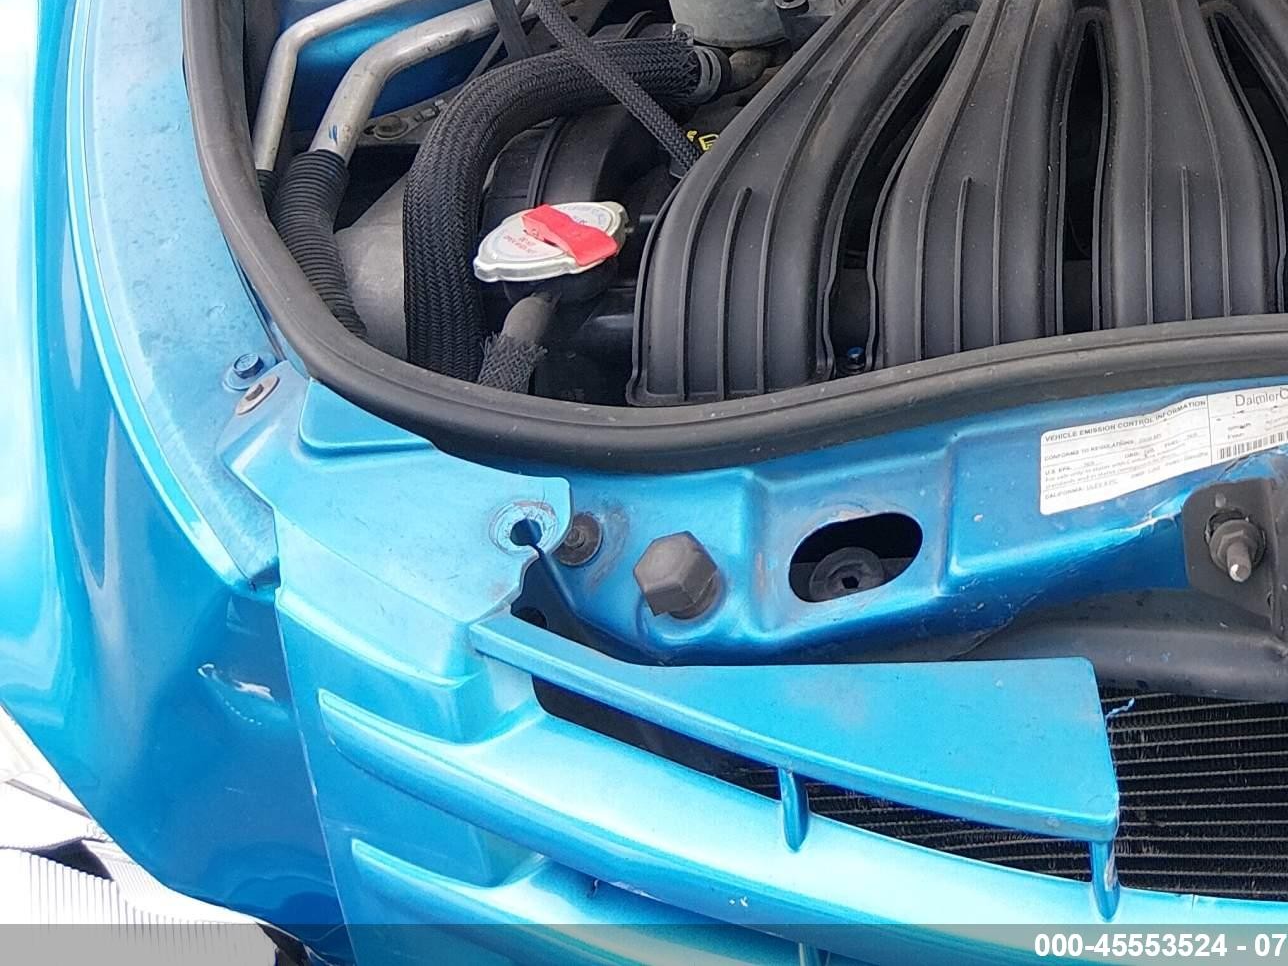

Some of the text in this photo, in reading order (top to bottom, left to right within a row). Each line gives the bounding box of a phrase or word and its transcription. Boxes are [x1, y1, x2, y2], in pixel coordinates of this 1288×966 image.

[1045, 400, 1206, 443] VEHICLE EMISSION CONTROL INFORMATION
